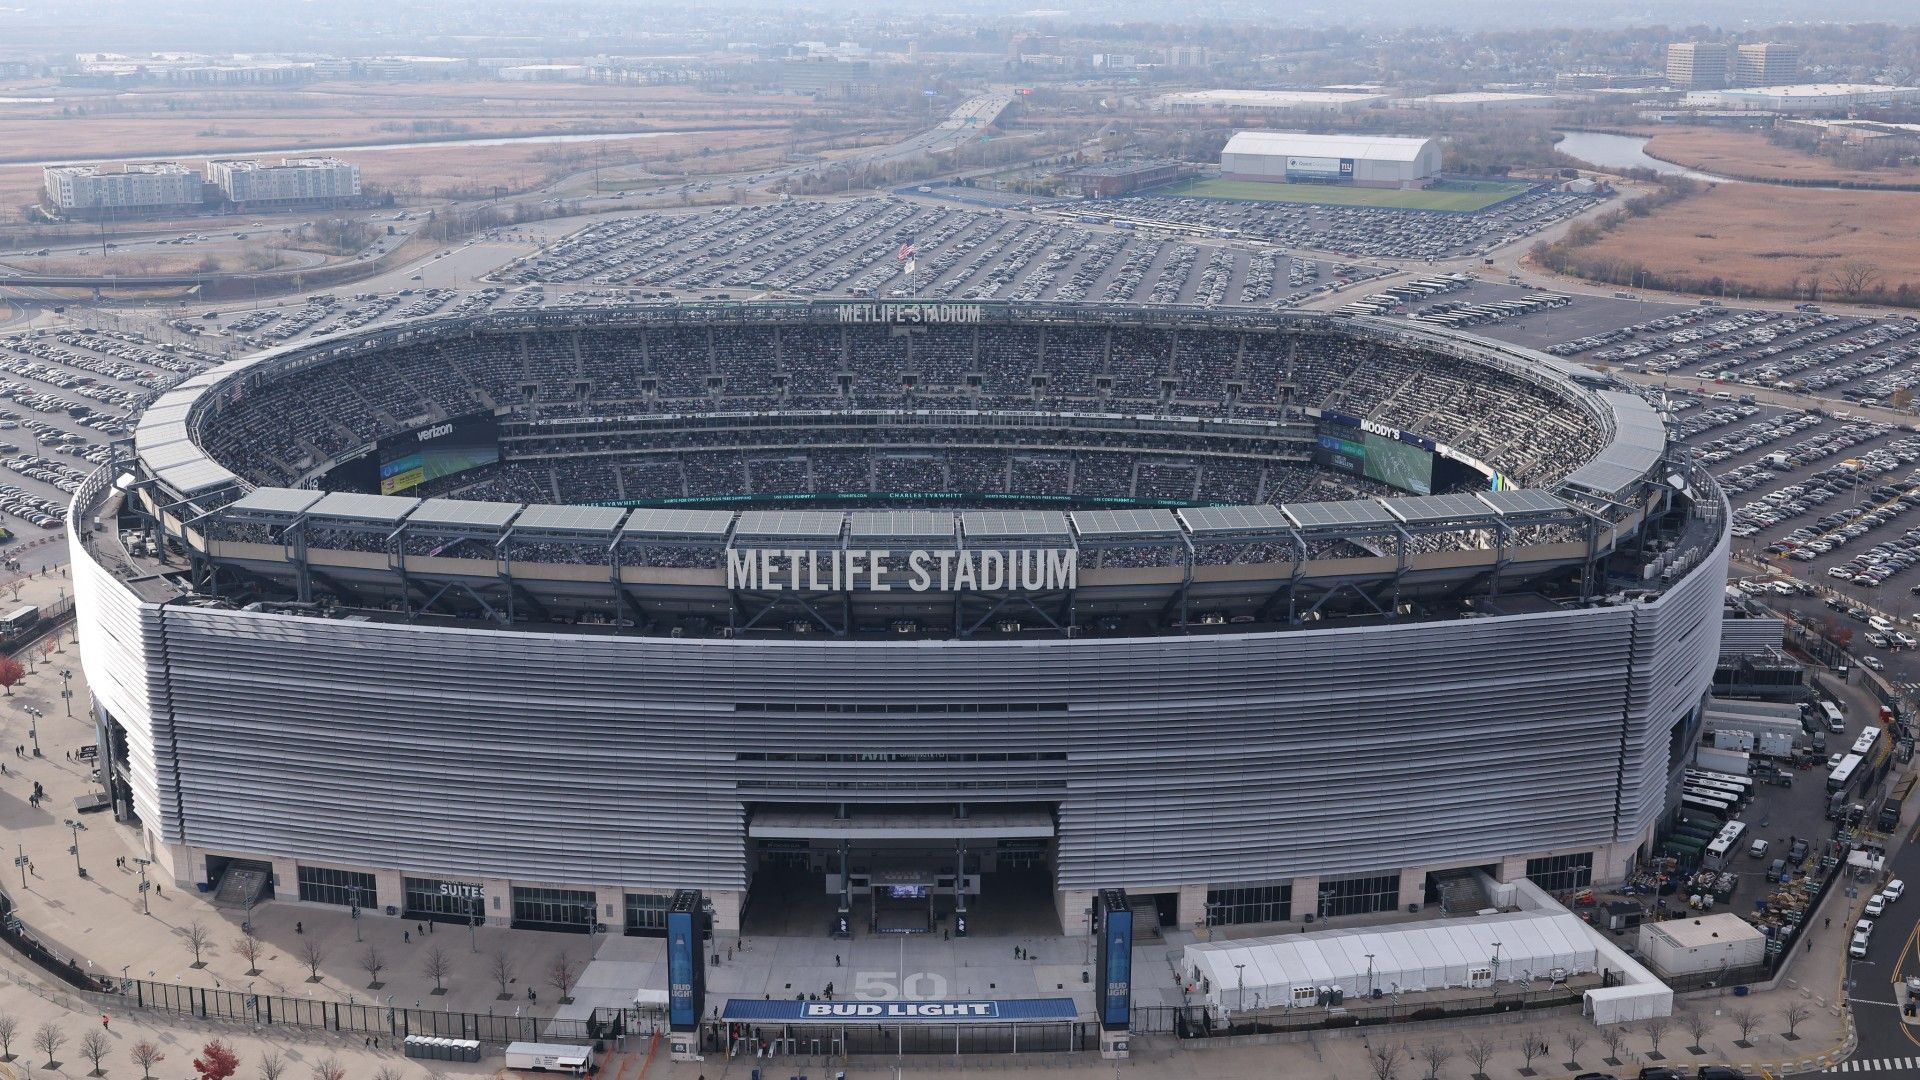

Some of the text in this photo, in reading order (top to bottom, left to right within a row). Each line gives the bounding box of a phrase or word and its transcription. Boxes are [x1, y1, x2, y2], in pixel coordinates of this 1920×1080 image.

[839, 304, 981, 323] METLIFE STADIUM
[416, 423, 453, 442] verizon
[1360, 419, 1401, 440] MOODY'S
[727, 549, 1077, 591] METLIFE STADIUM
[440, 884, 486, 898] SUITES
[671, 990, 693, 998] LIGHT
[672, 983, 691, 991] BUD
[854, 971, 948, 1001] 50
[1107, 988, 1128, 996] LIGHT
[808, 1004, 990, 1016] BUD LIGHT
